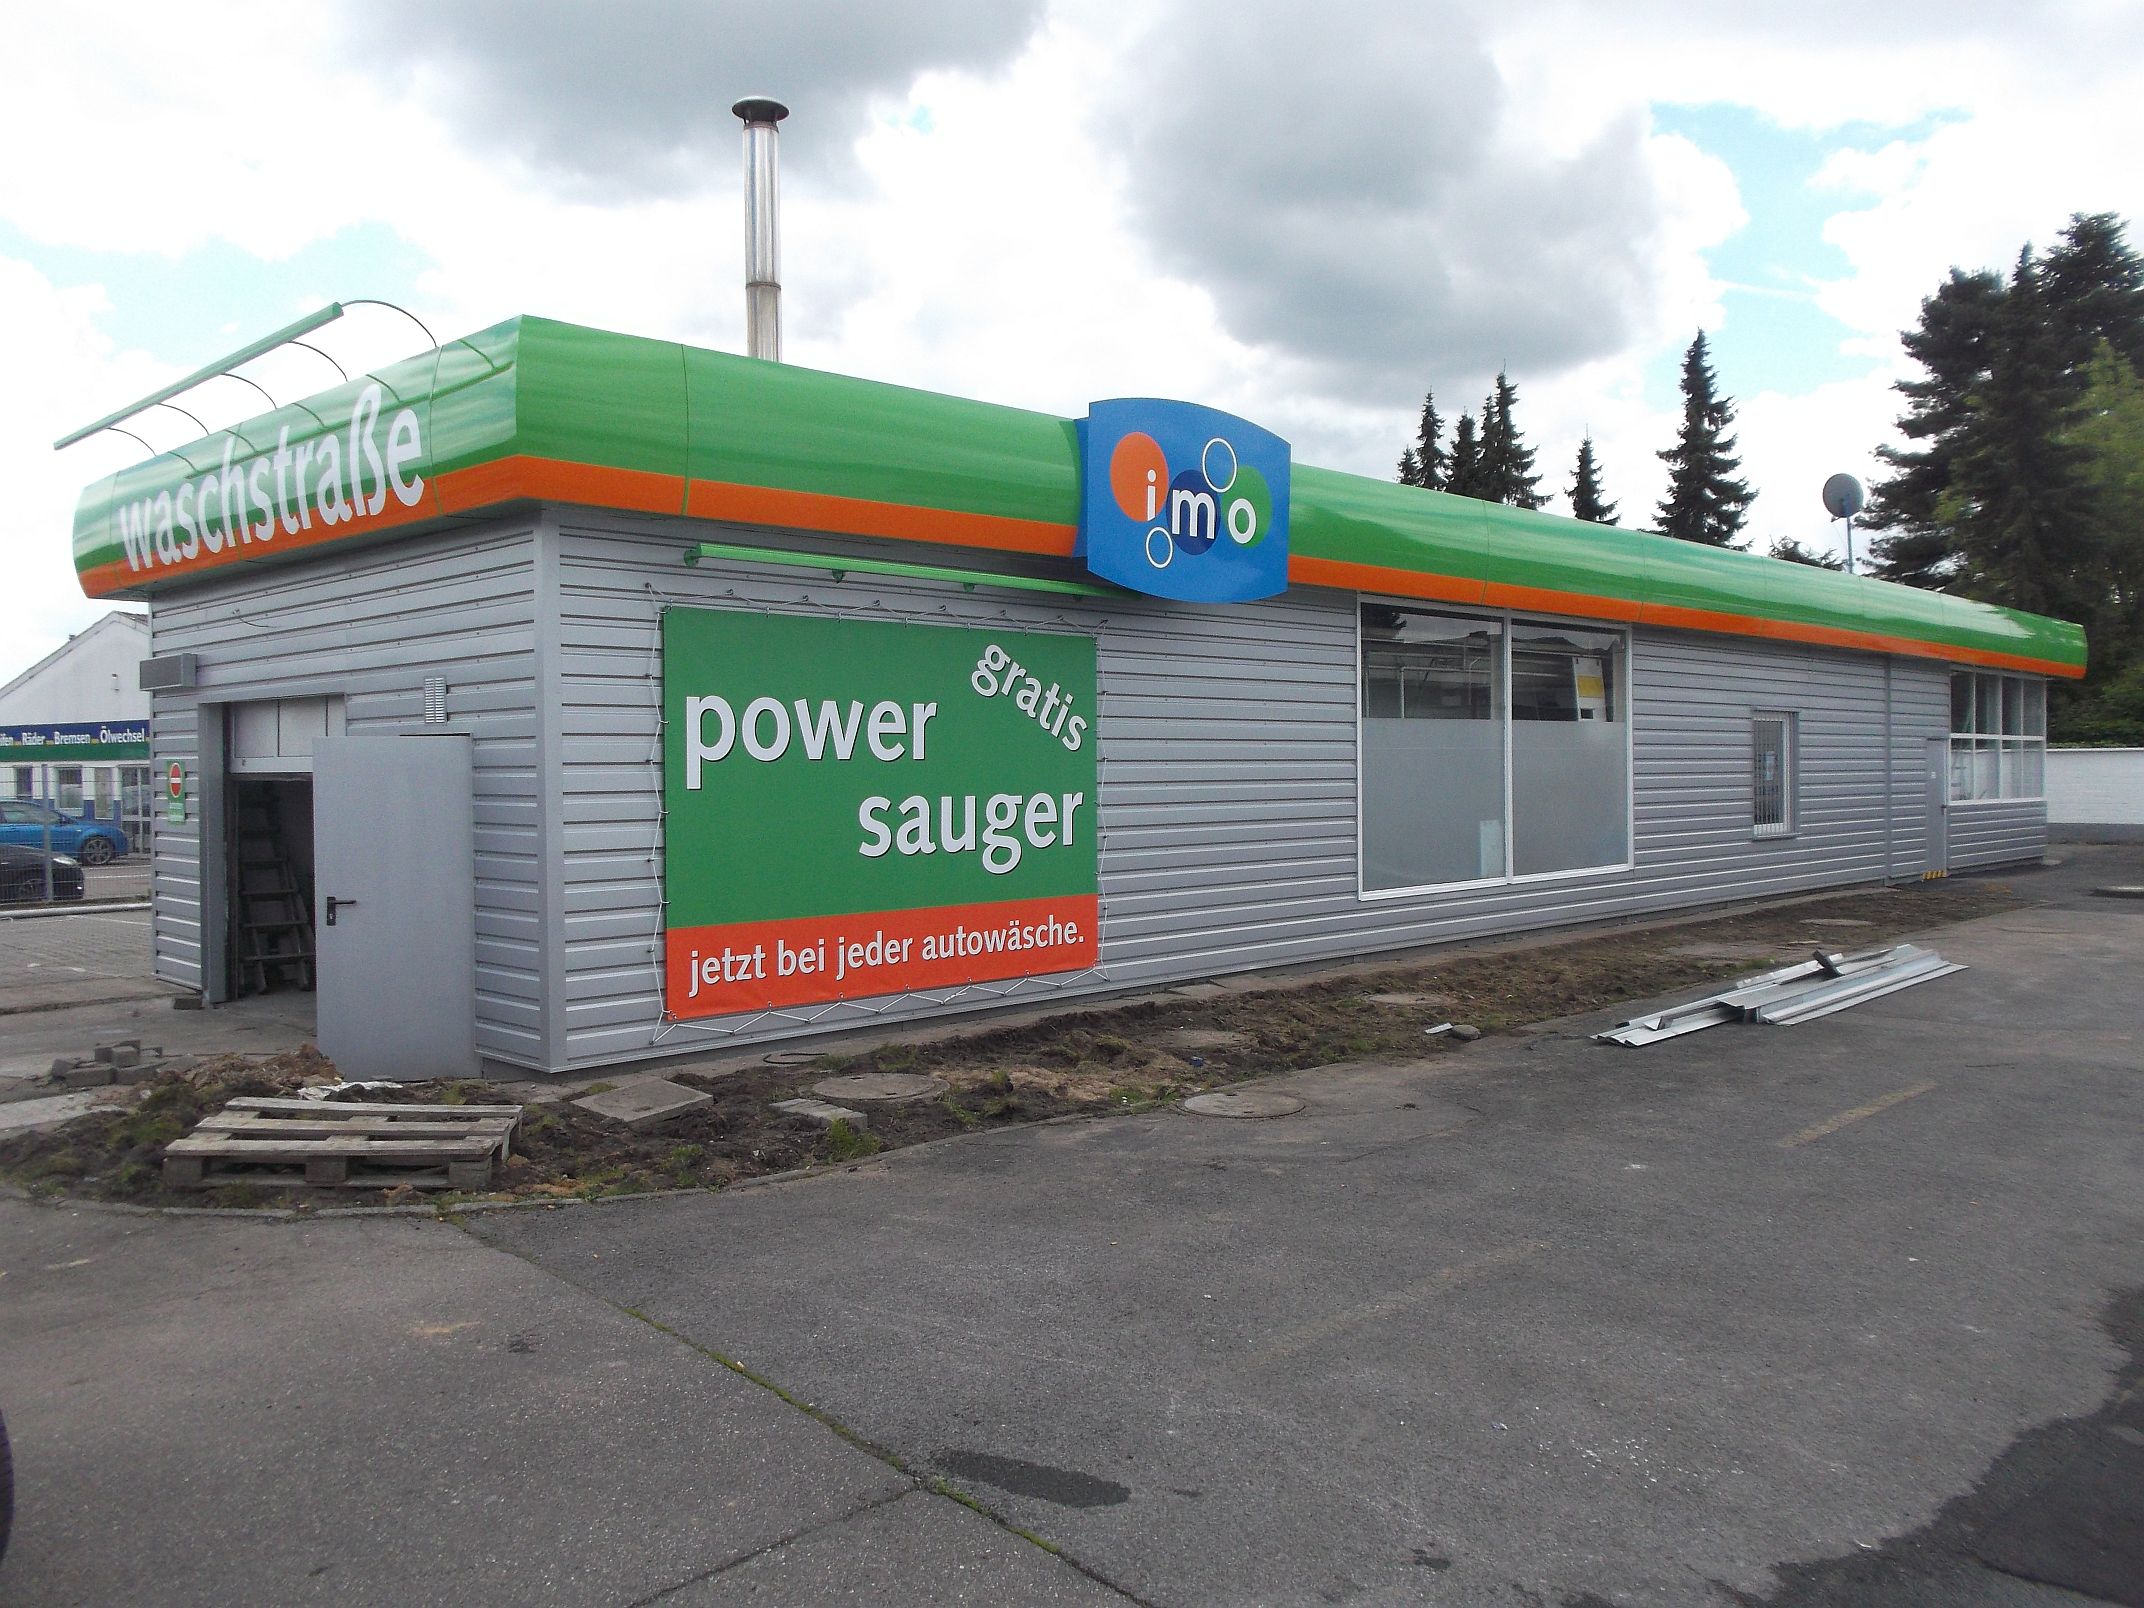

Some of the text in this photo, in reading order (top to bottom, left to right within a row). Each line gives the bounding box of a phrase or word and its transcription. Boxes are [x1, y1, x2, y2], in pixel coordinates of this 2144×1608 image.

[120, 383, 425, 572] waschstraße
[1147, 469, 1257, 544] imo
[21, 732, 46, 746] Räder
[53, 731, 91, 745] Bremsen
[99, 725, 145, 744] Ölwechsel
[971, 644, 1088, 751] gratis
[686, 695, 938, 790] power
[858, 792, 1083, 874] sauger
[688, 914, 1085, 998] jetzt bei jeder autowäsche.
